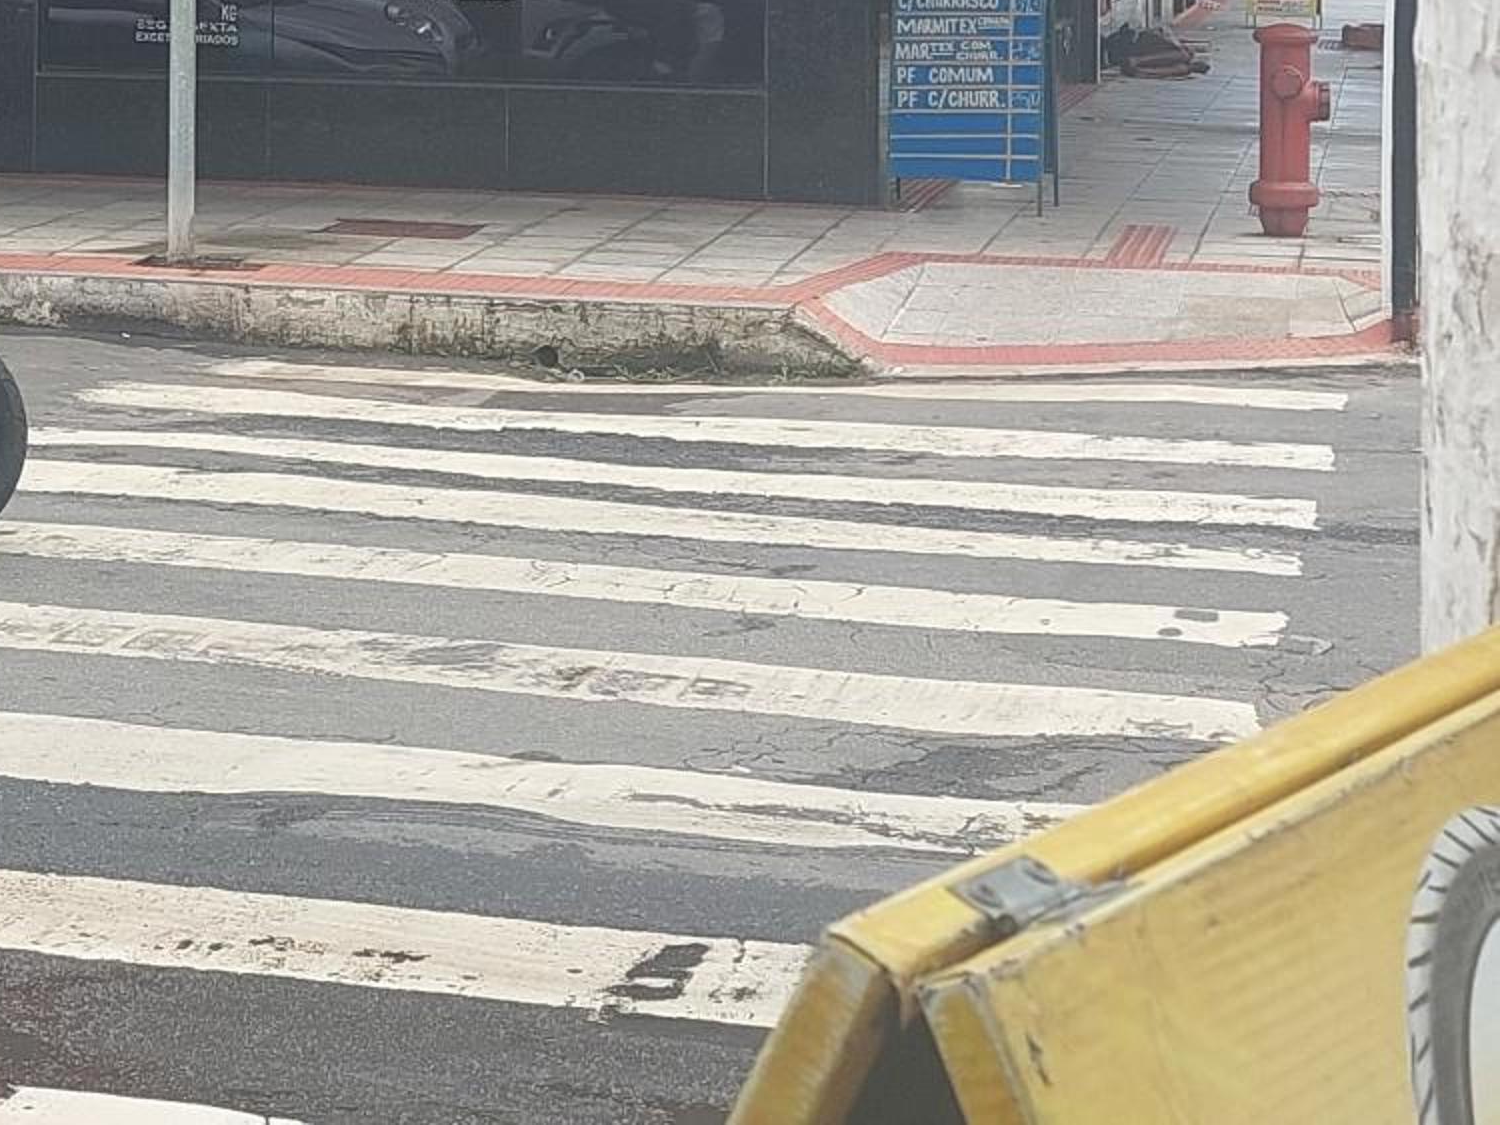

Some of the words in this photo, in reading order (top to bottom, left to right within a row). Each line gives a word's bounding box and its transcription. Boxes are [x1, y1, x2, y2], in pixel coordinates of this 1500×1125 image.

[897, 18, 977, 34] MARMITEX
[897, 67, 916, 83] PF
[929, 67, 994, 83] COMUM
[897, 91, 919, 108] PF
[928, 90, 1006, 108] C/CHURR.
